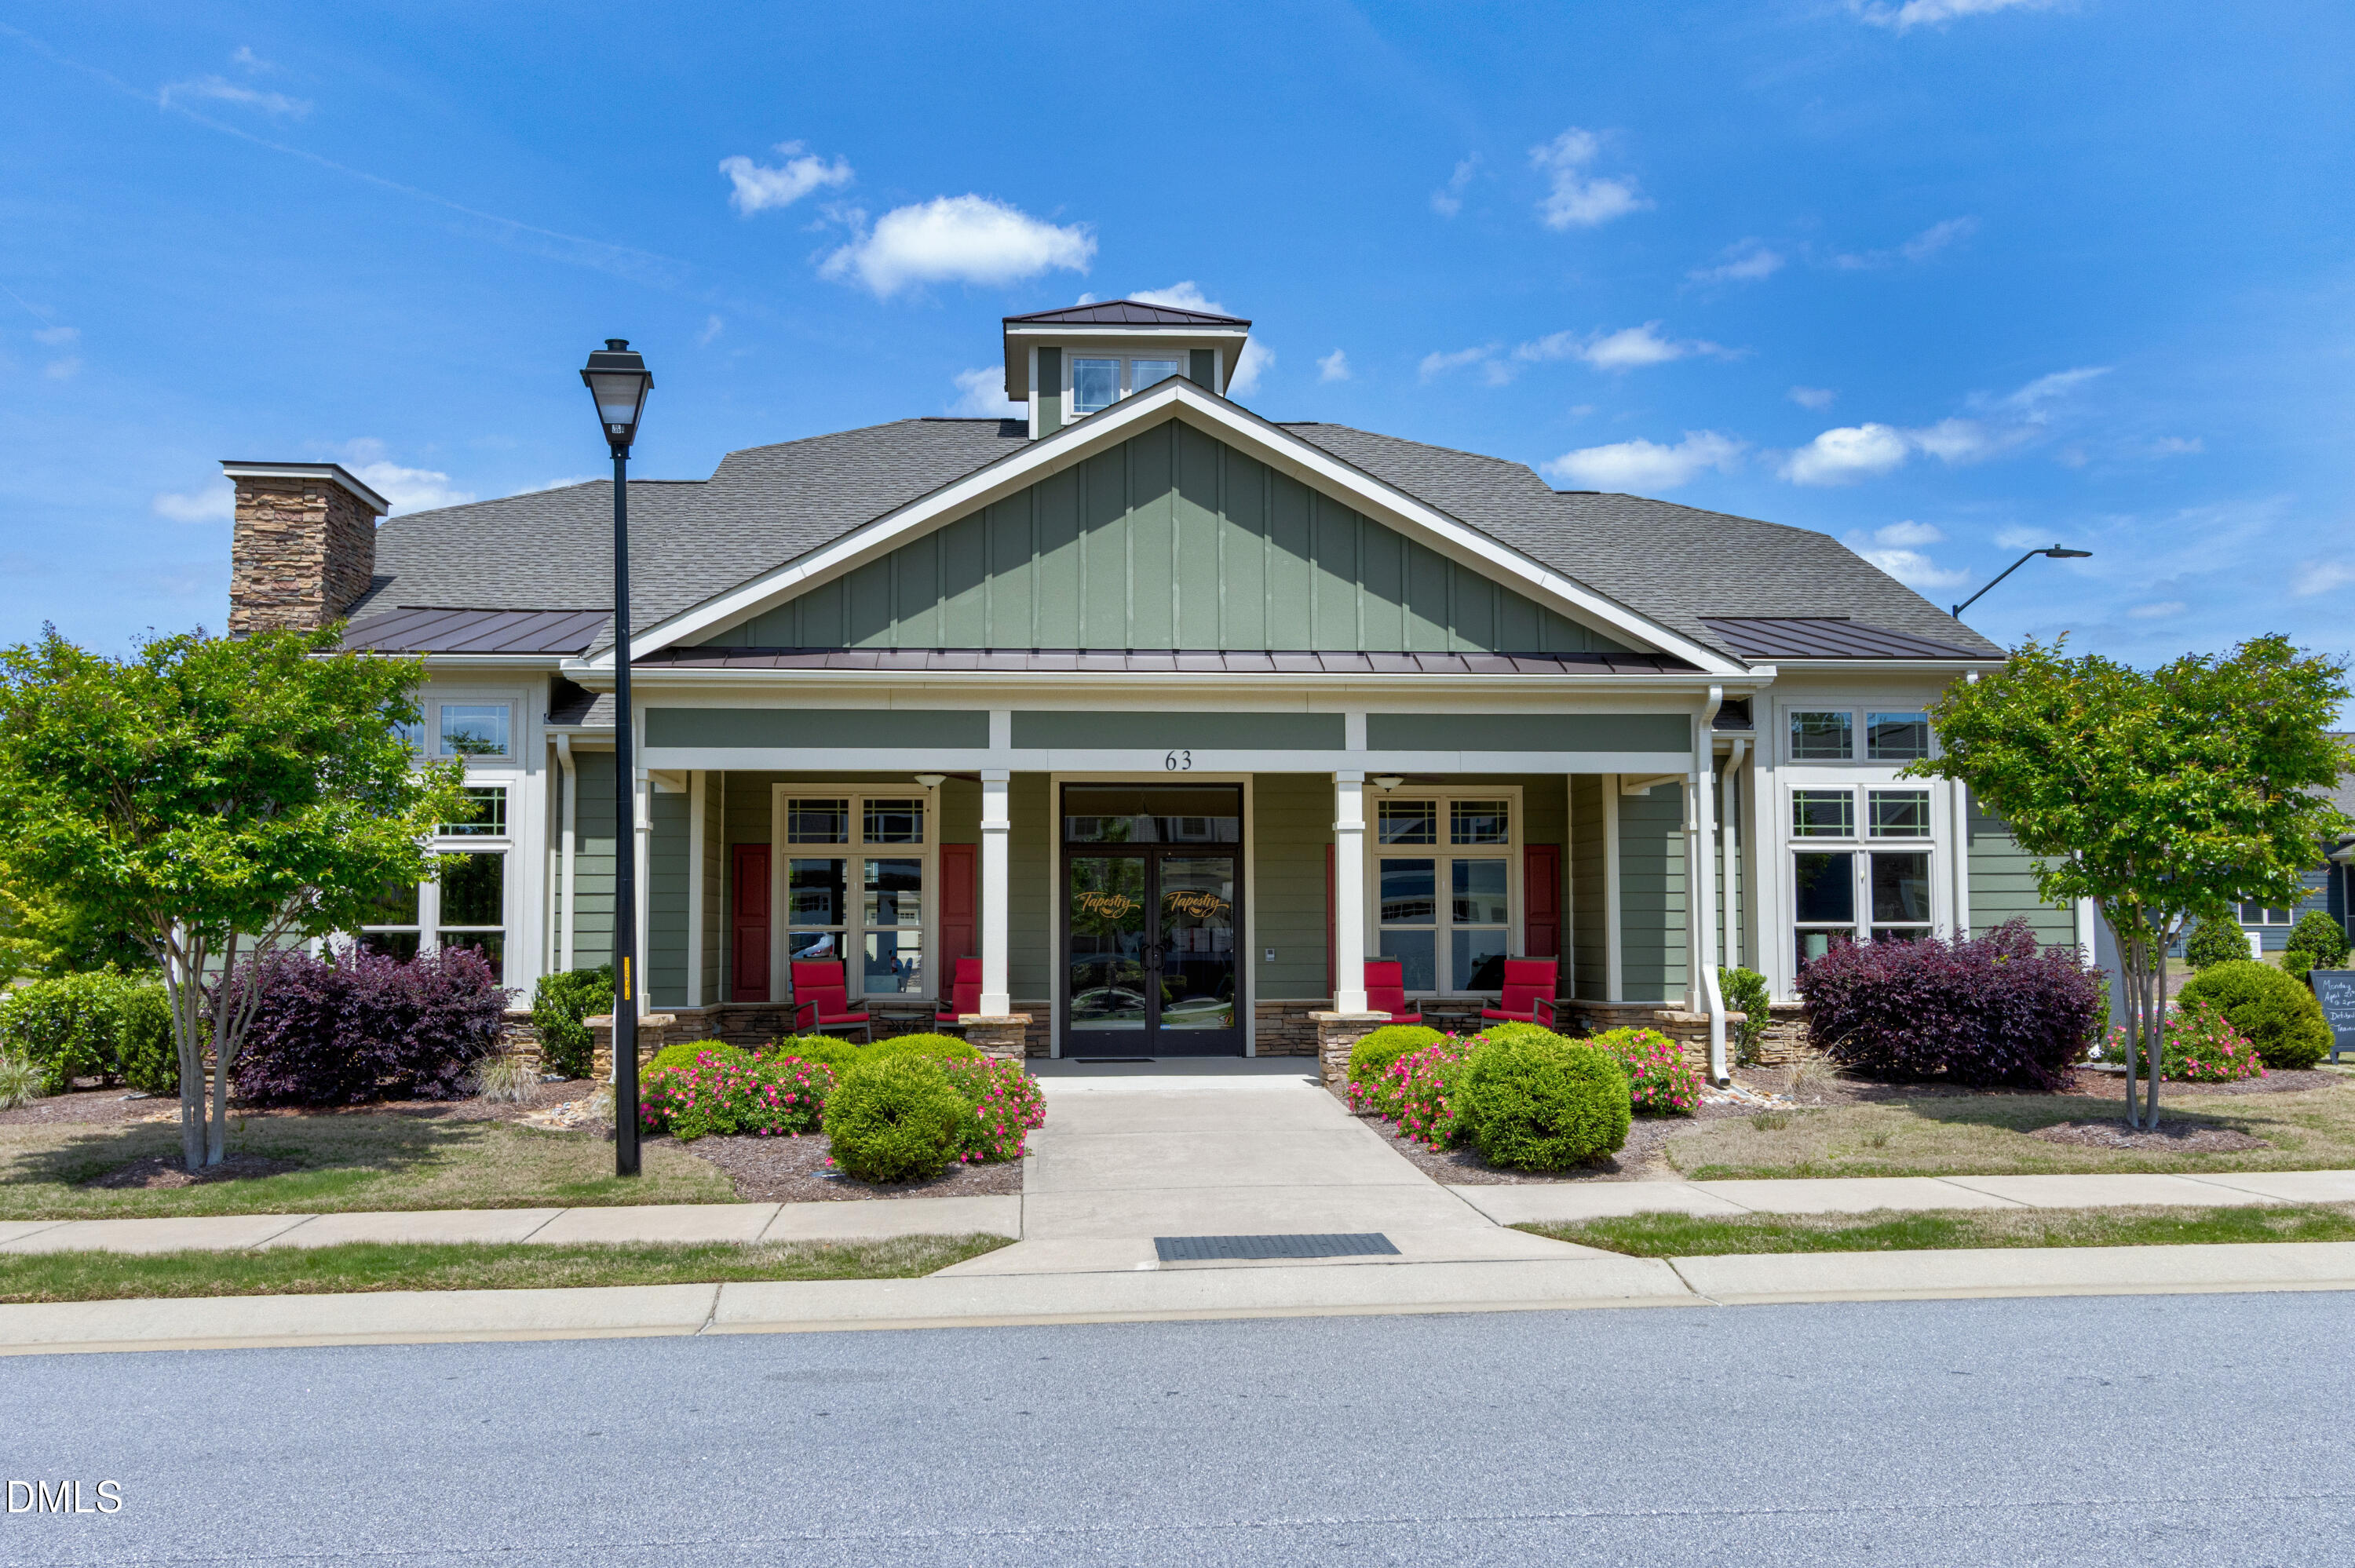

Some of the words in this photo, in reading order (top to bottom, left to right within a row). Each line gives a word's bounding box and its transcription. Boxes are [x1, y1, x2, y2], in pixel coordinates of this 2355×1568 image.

[1166, 749, 1192, 771] 63
[1075, 892, 1141, 918] Tapestry
[1164, 891, 1229, 918] Tapestry
[2322, 979, 2351, 992] Monday
[2324, 991, 2340, 1003] April
